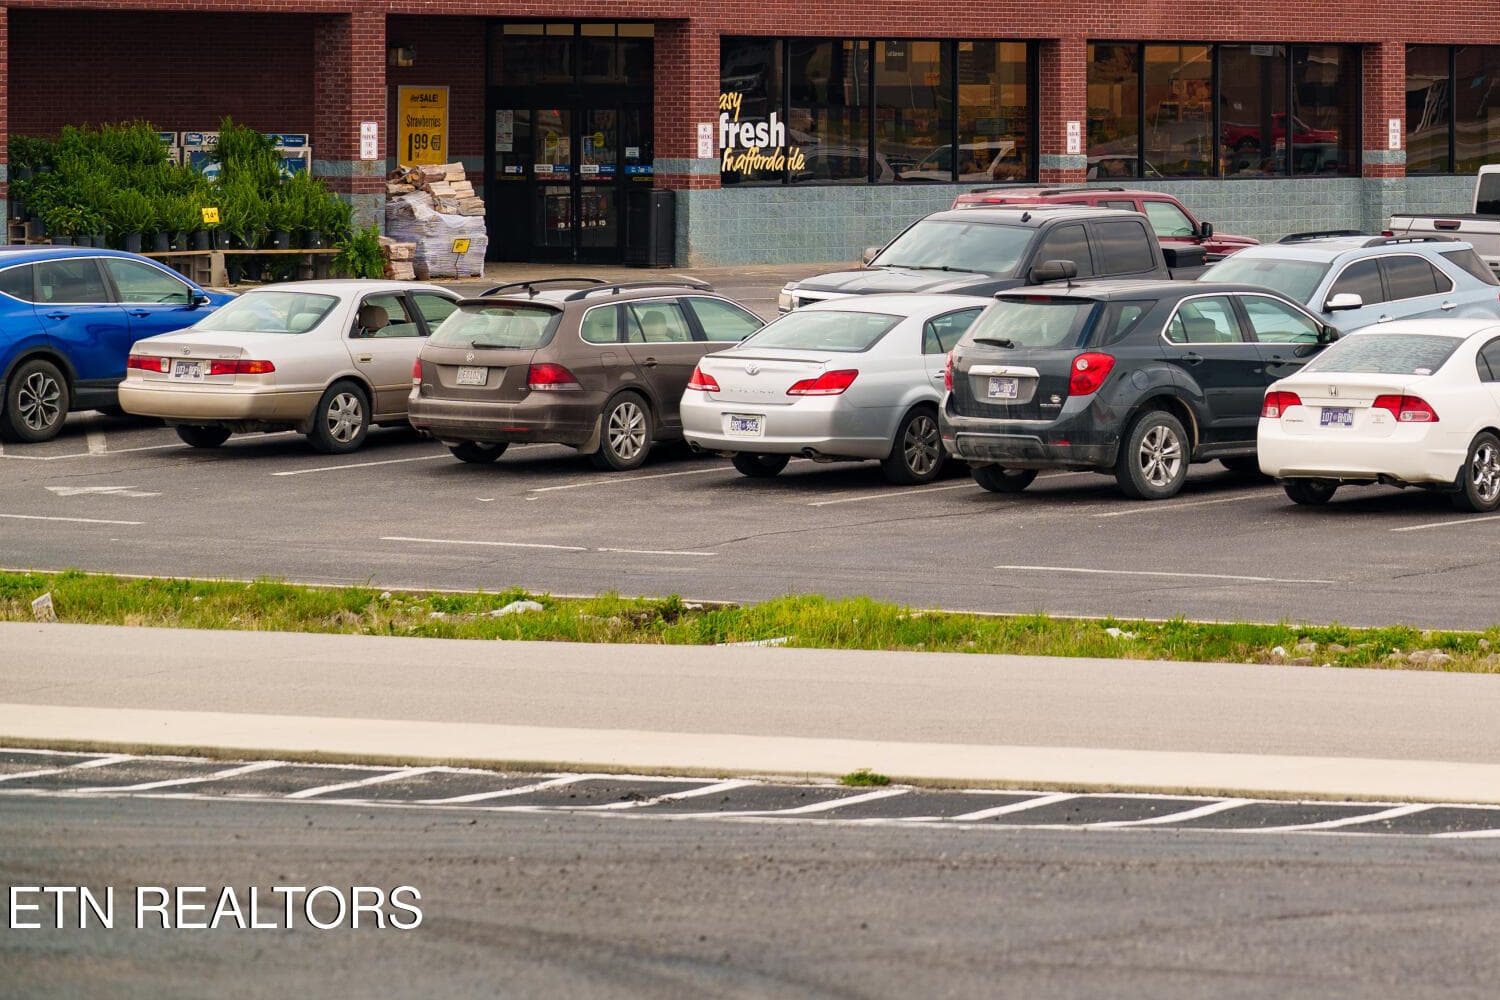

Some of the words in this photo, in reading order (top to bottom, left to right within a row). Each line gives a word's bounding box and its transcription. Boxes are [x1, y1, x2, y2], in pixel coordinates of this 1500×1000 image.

[406, 114, 442, 128] Strawberries
[719, 92, 743, 122] asy
[719, 112, 786, 149] fresh
